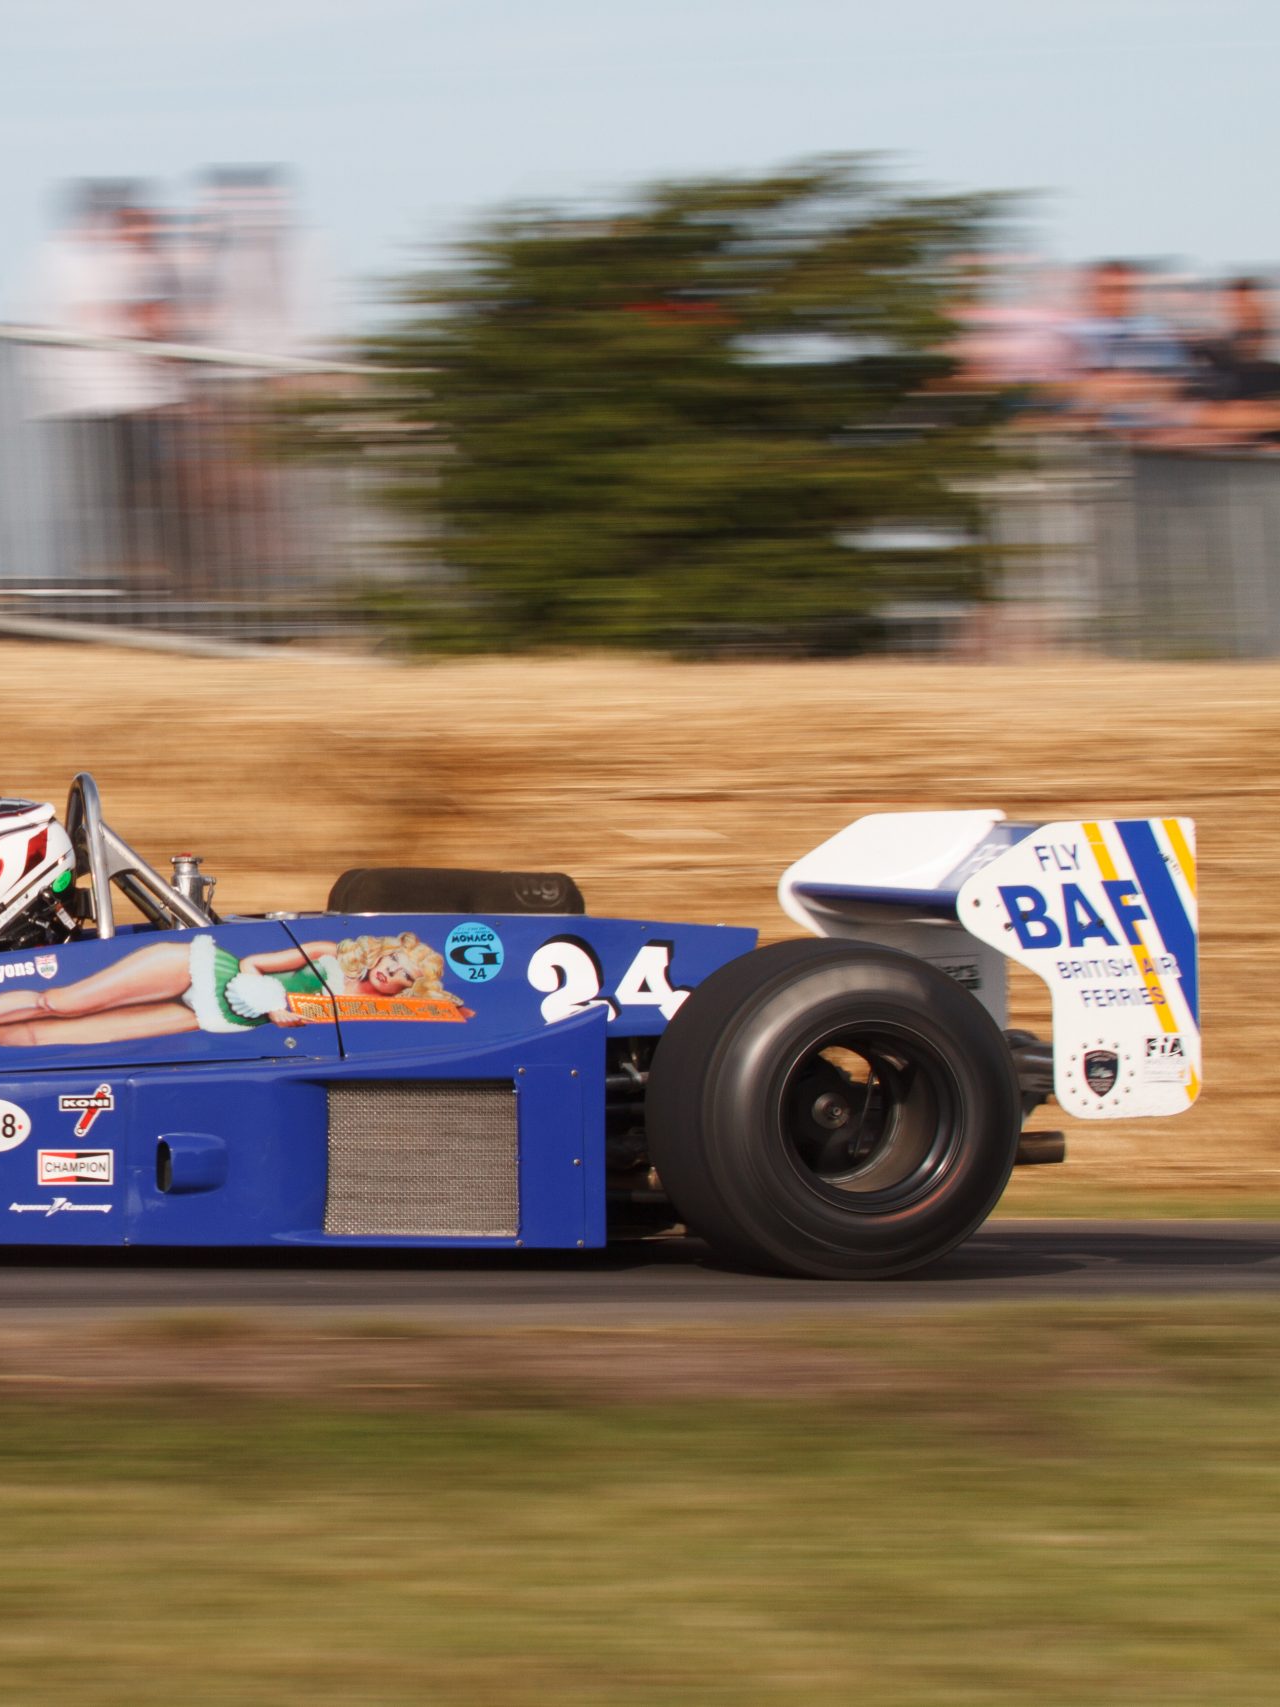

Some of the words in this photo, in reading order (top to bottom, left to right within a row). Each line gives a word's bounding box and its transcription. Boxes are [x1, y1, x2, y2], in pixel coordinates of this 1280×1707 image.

[1034, 844, 1081, 872] FLY
[997, 880, 1148, 950] BAF
[451, 933, 495, 943] MONACO
[449, 944, 501, 966] G
[468, 967, 487, 980] 24
[1056, 957, 1138, 979] BRITISH
[1142, 955, 1181, 978] AIR
[527, 934, 692, 1026] 24
[1081, 986, 1166, 1008] FERRIES
[63, 1099, 110, 1108] KONI
[44, 1161, 107, 1174] CHAMPION
